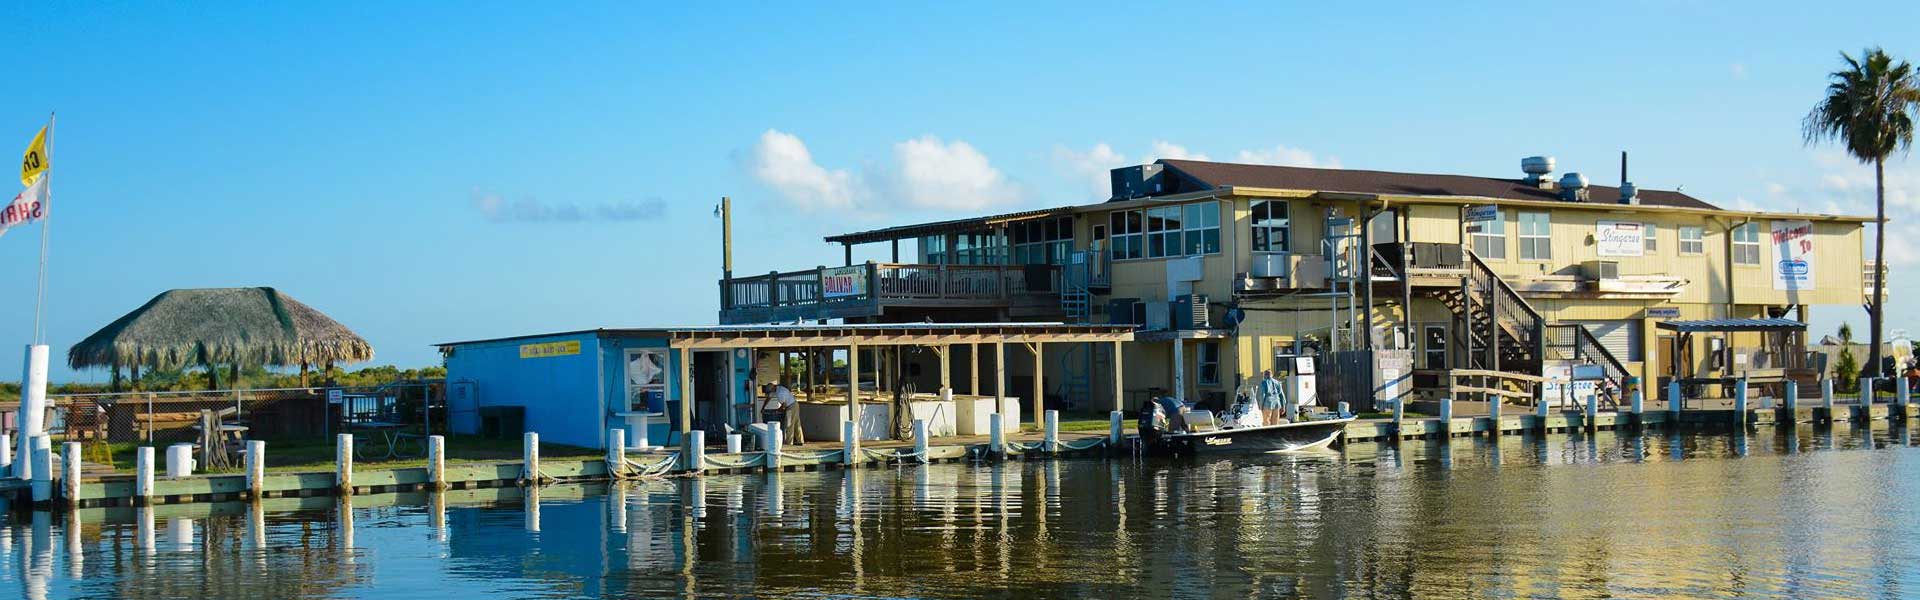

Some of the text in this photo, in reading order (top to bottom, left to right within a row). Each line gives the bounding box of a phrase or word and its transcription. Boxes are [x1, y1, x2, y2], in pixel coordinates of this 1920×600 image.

[1772, 224, 1811, 245] Welcome
[1800, 239, 1811, 254] To
[825, 276, 852, 293] BOLIVAR
